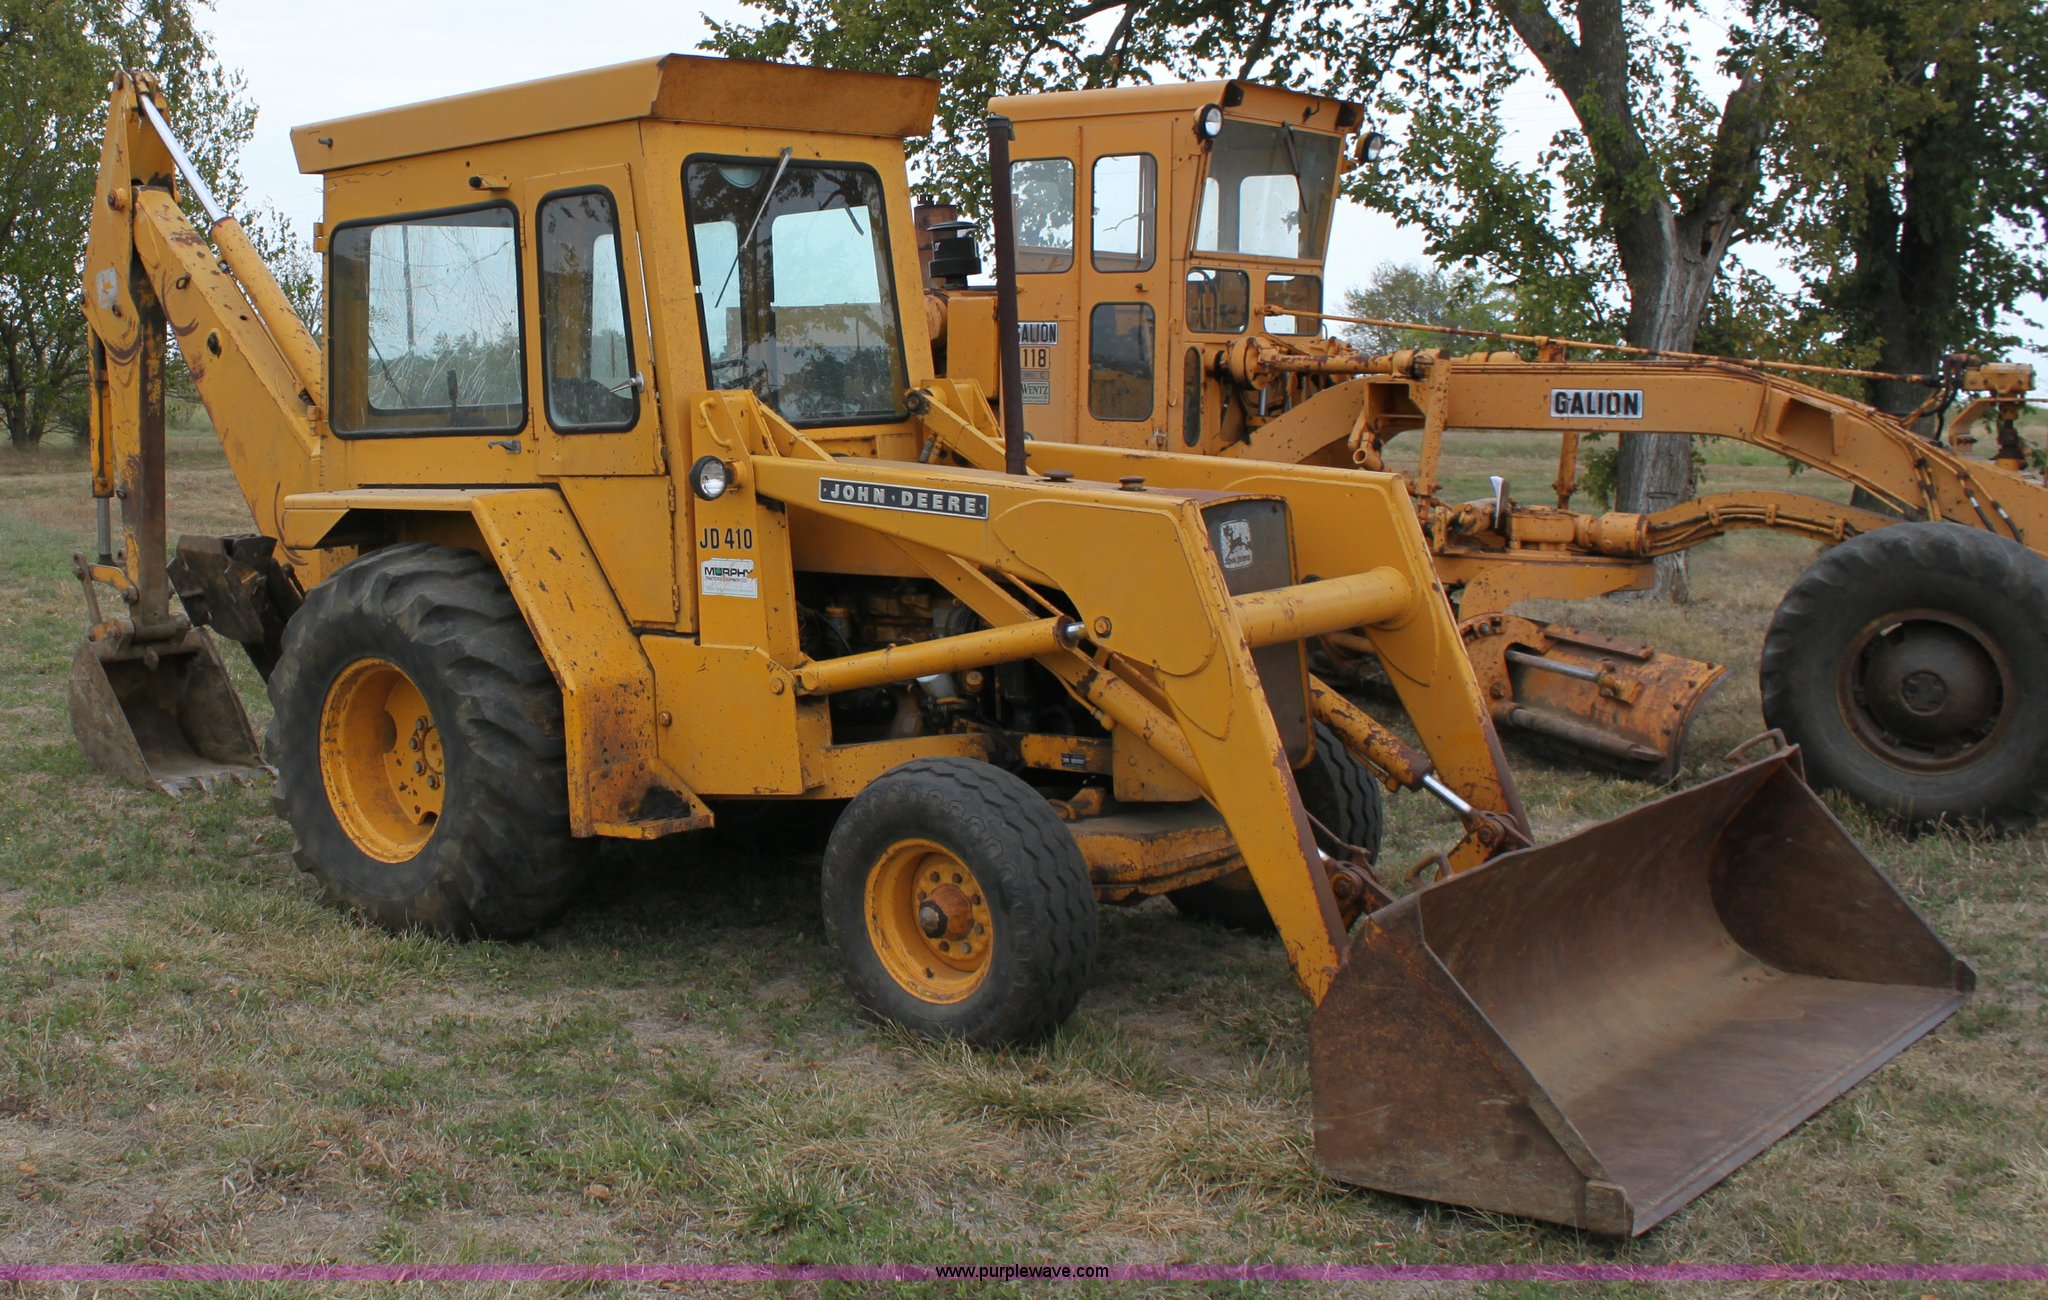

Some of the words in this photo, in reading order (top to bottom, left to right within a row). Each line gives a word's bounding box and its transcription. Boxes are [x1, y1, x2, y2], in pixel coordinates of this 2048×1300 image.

[1023, 349, 1046, 367] 118
[1021, 383, 1048, 395] WENTZ
[1554, 391, 1639, 415] GALION
[830, 484, 885, 504] JOHN
[901, 491, 977, 513] DEERE
[700, 528, 720, 549] JD
[724, 528, 752, 549] 410
[704, 566, 753, 577] MURPHY
